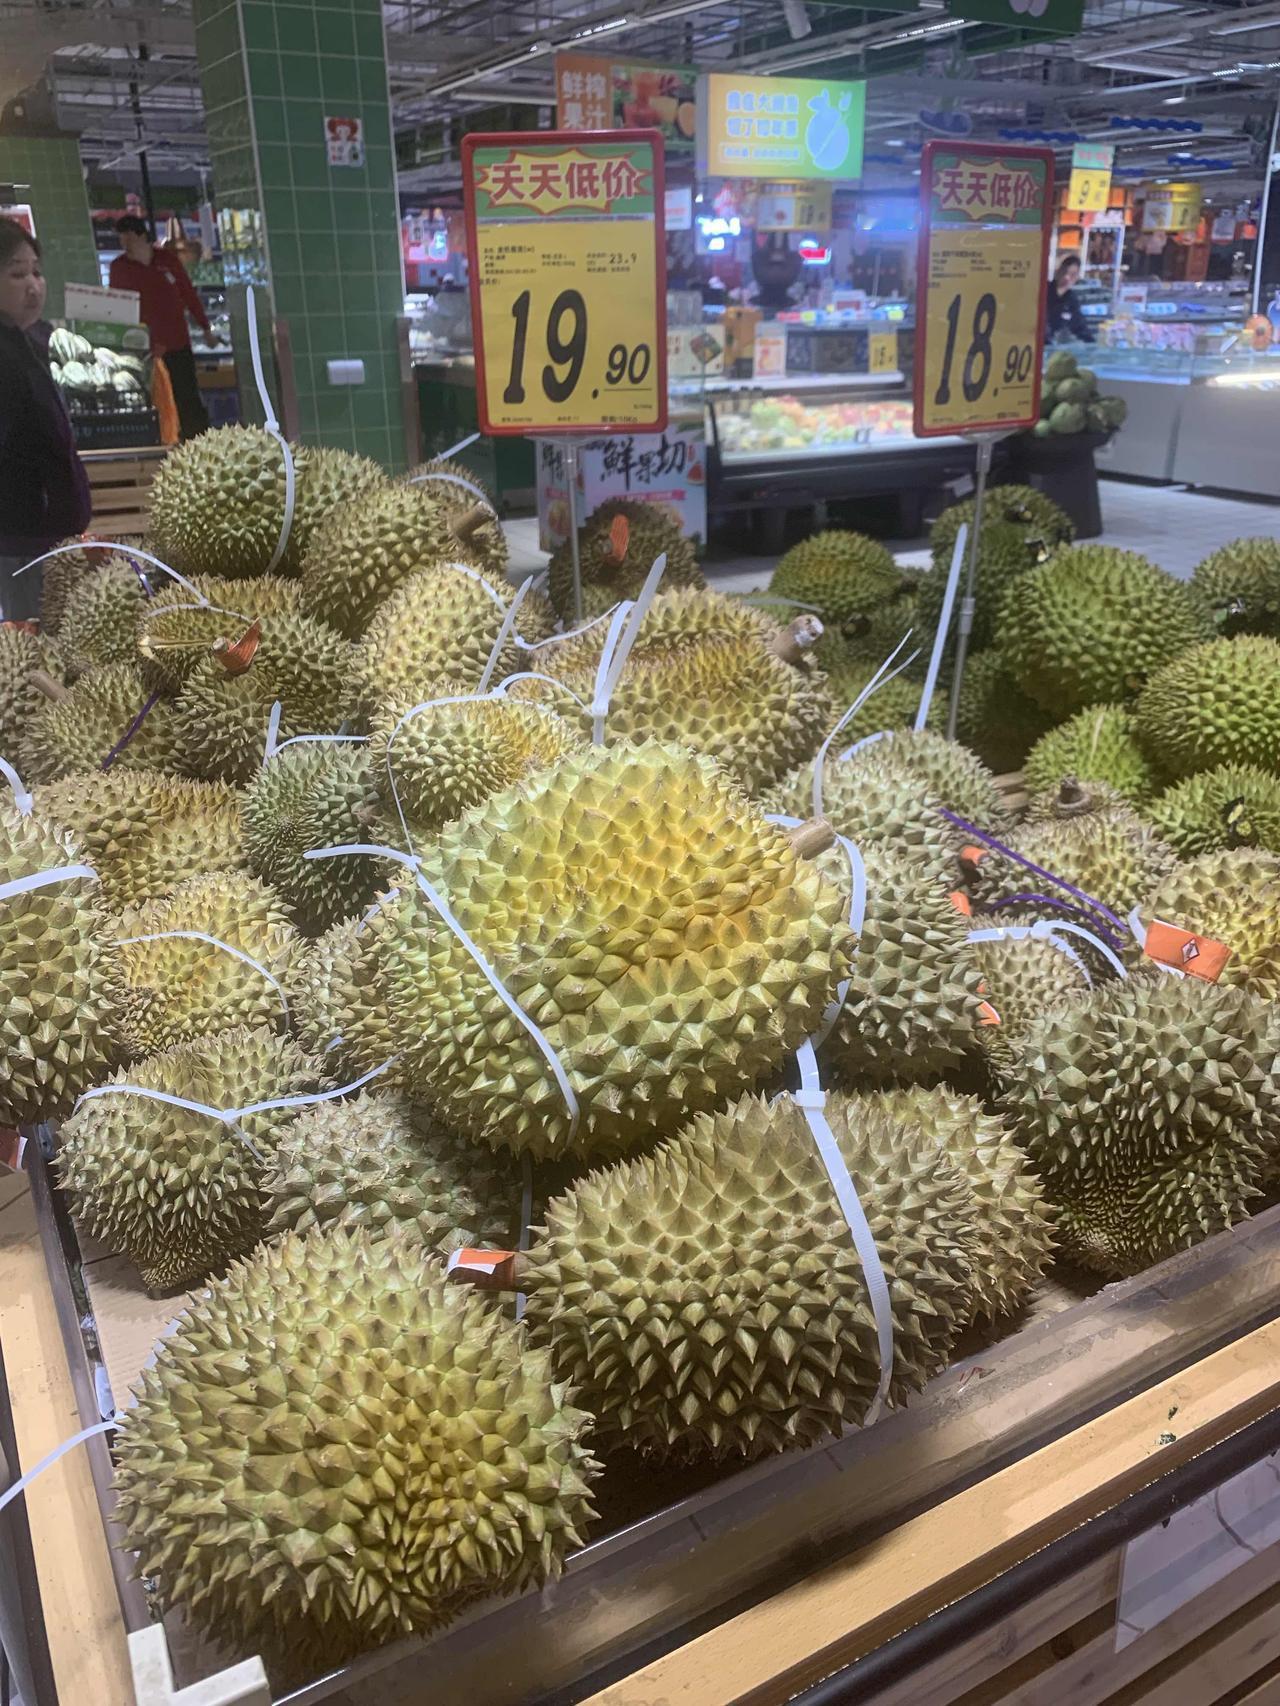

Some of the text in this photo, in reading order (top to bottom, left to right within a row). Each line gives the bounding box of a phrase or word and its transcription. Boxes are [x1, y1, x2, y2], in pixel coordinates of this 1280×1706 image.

[562, 71, 607, 100] 鲜榨
[562, 102, 608, 129] 果汁
[490, 160, 640, 204] 天天低价
[941, 169, 1040, 210] 天天低价
[599, 433, 686, 491] 鲜果切
